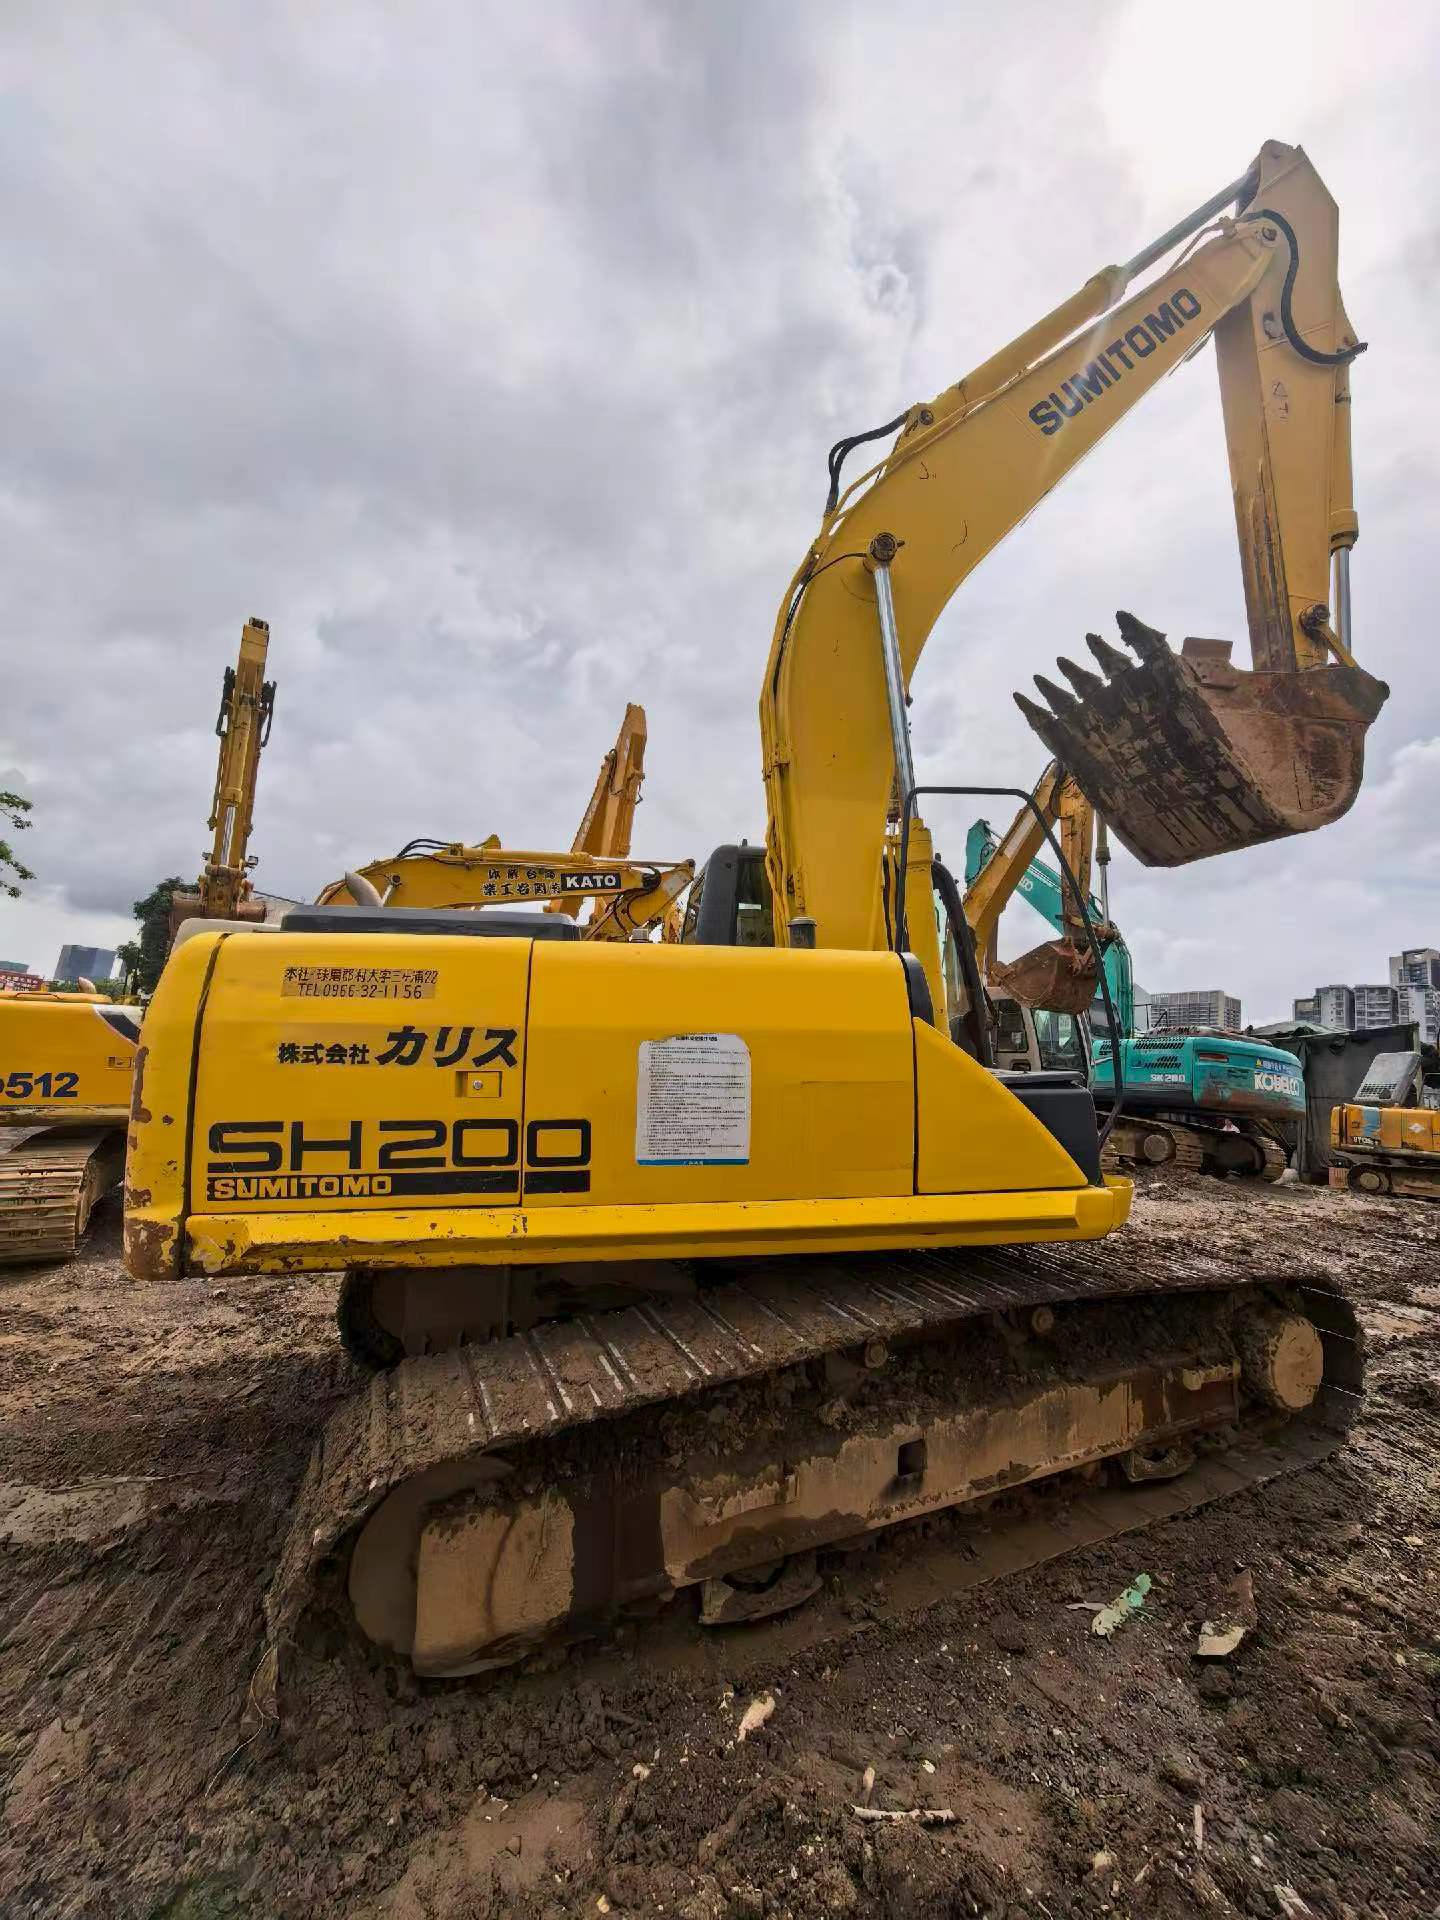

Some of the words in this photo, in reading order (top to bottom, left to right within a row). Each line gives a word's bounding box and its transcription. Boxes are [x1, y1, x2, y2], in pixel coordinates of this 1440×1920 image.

[1029, 288, 1201, 435] SUMITOMO
[566, 875, 616, 889] KATO
[0, 1072, 79, 1098] 512
[207, 1119, 592, 1174] SH200
[214, 1176, 392, 1199] SUMITOMO
